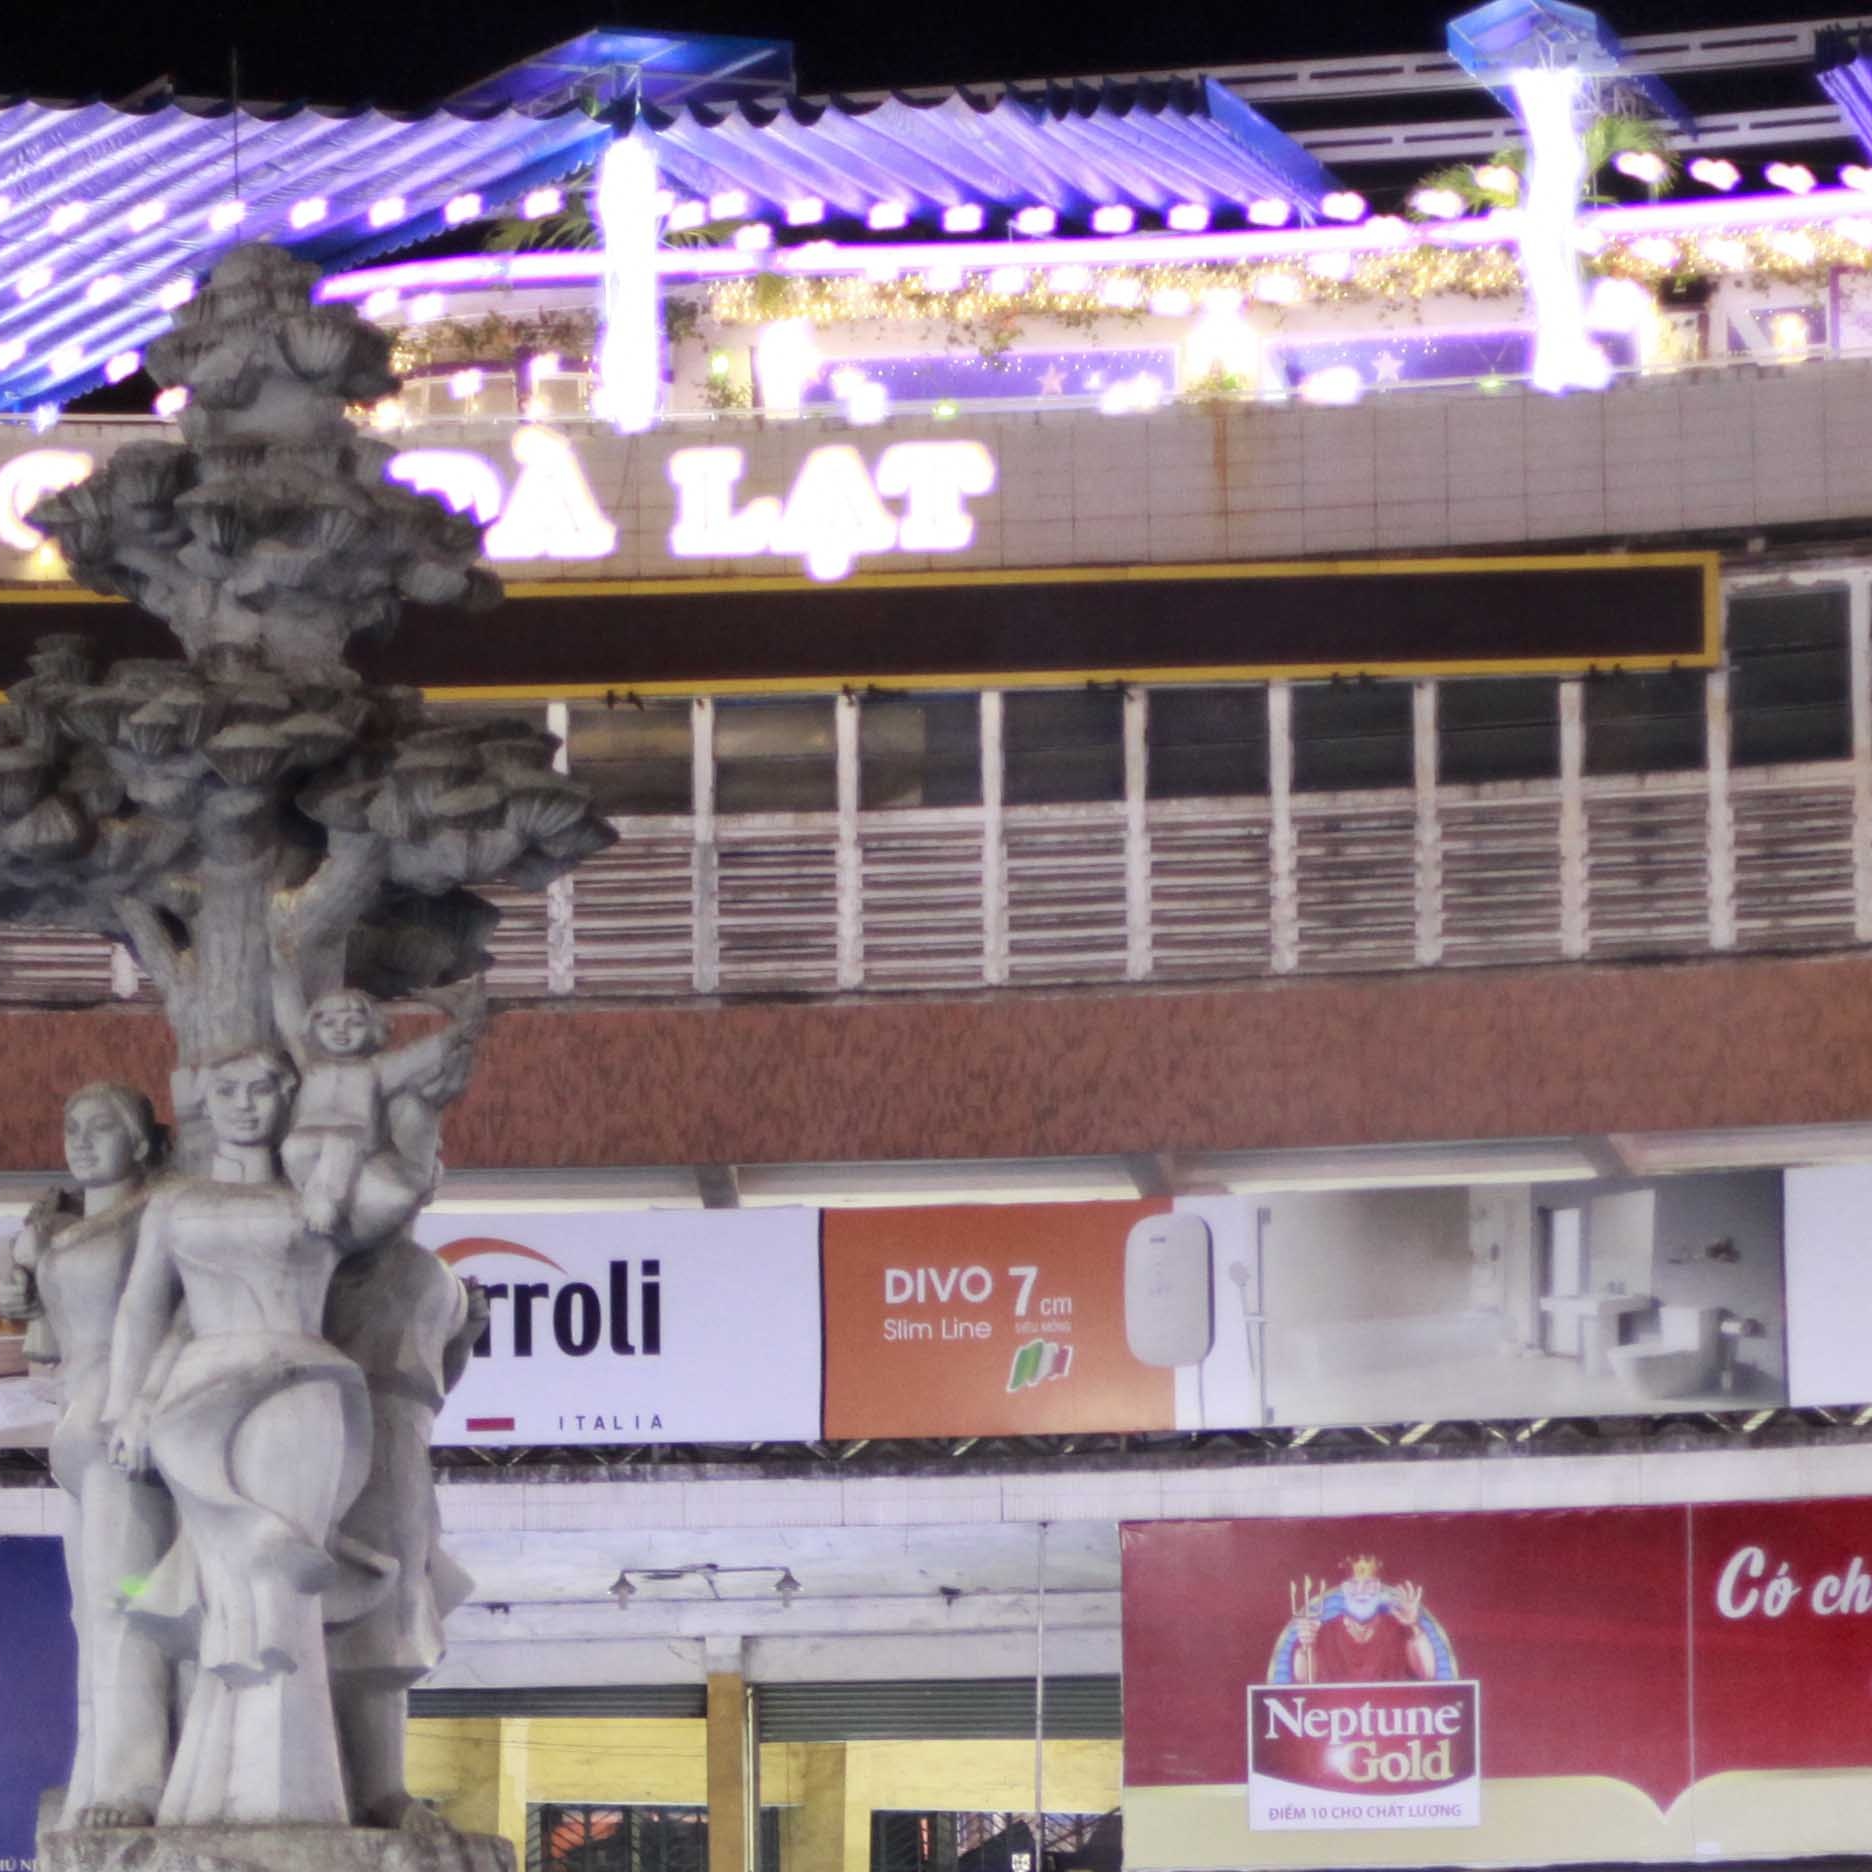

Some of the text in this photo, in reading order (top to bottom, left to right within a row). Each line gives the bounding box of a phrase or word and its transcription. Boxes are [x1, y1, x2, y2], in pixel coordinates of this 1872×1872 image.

[468, 1259, 662, 1357] rroli
[884, 1265, 1073, 1318] DIVO 7 cm
[883, 1316, 993, 1341] Slim Line
[558, 1414, 664, 1433] ITALIA
[1716, 1546, 1800, 1618] Có
[1264, 1698, 1462, 1745] Neptune
[1339, 1739, 1455, 1785] Gold
[1267, 1799, 1463, 1822] ĐIỂM 10 CHO CHẤT LƯỢNG
